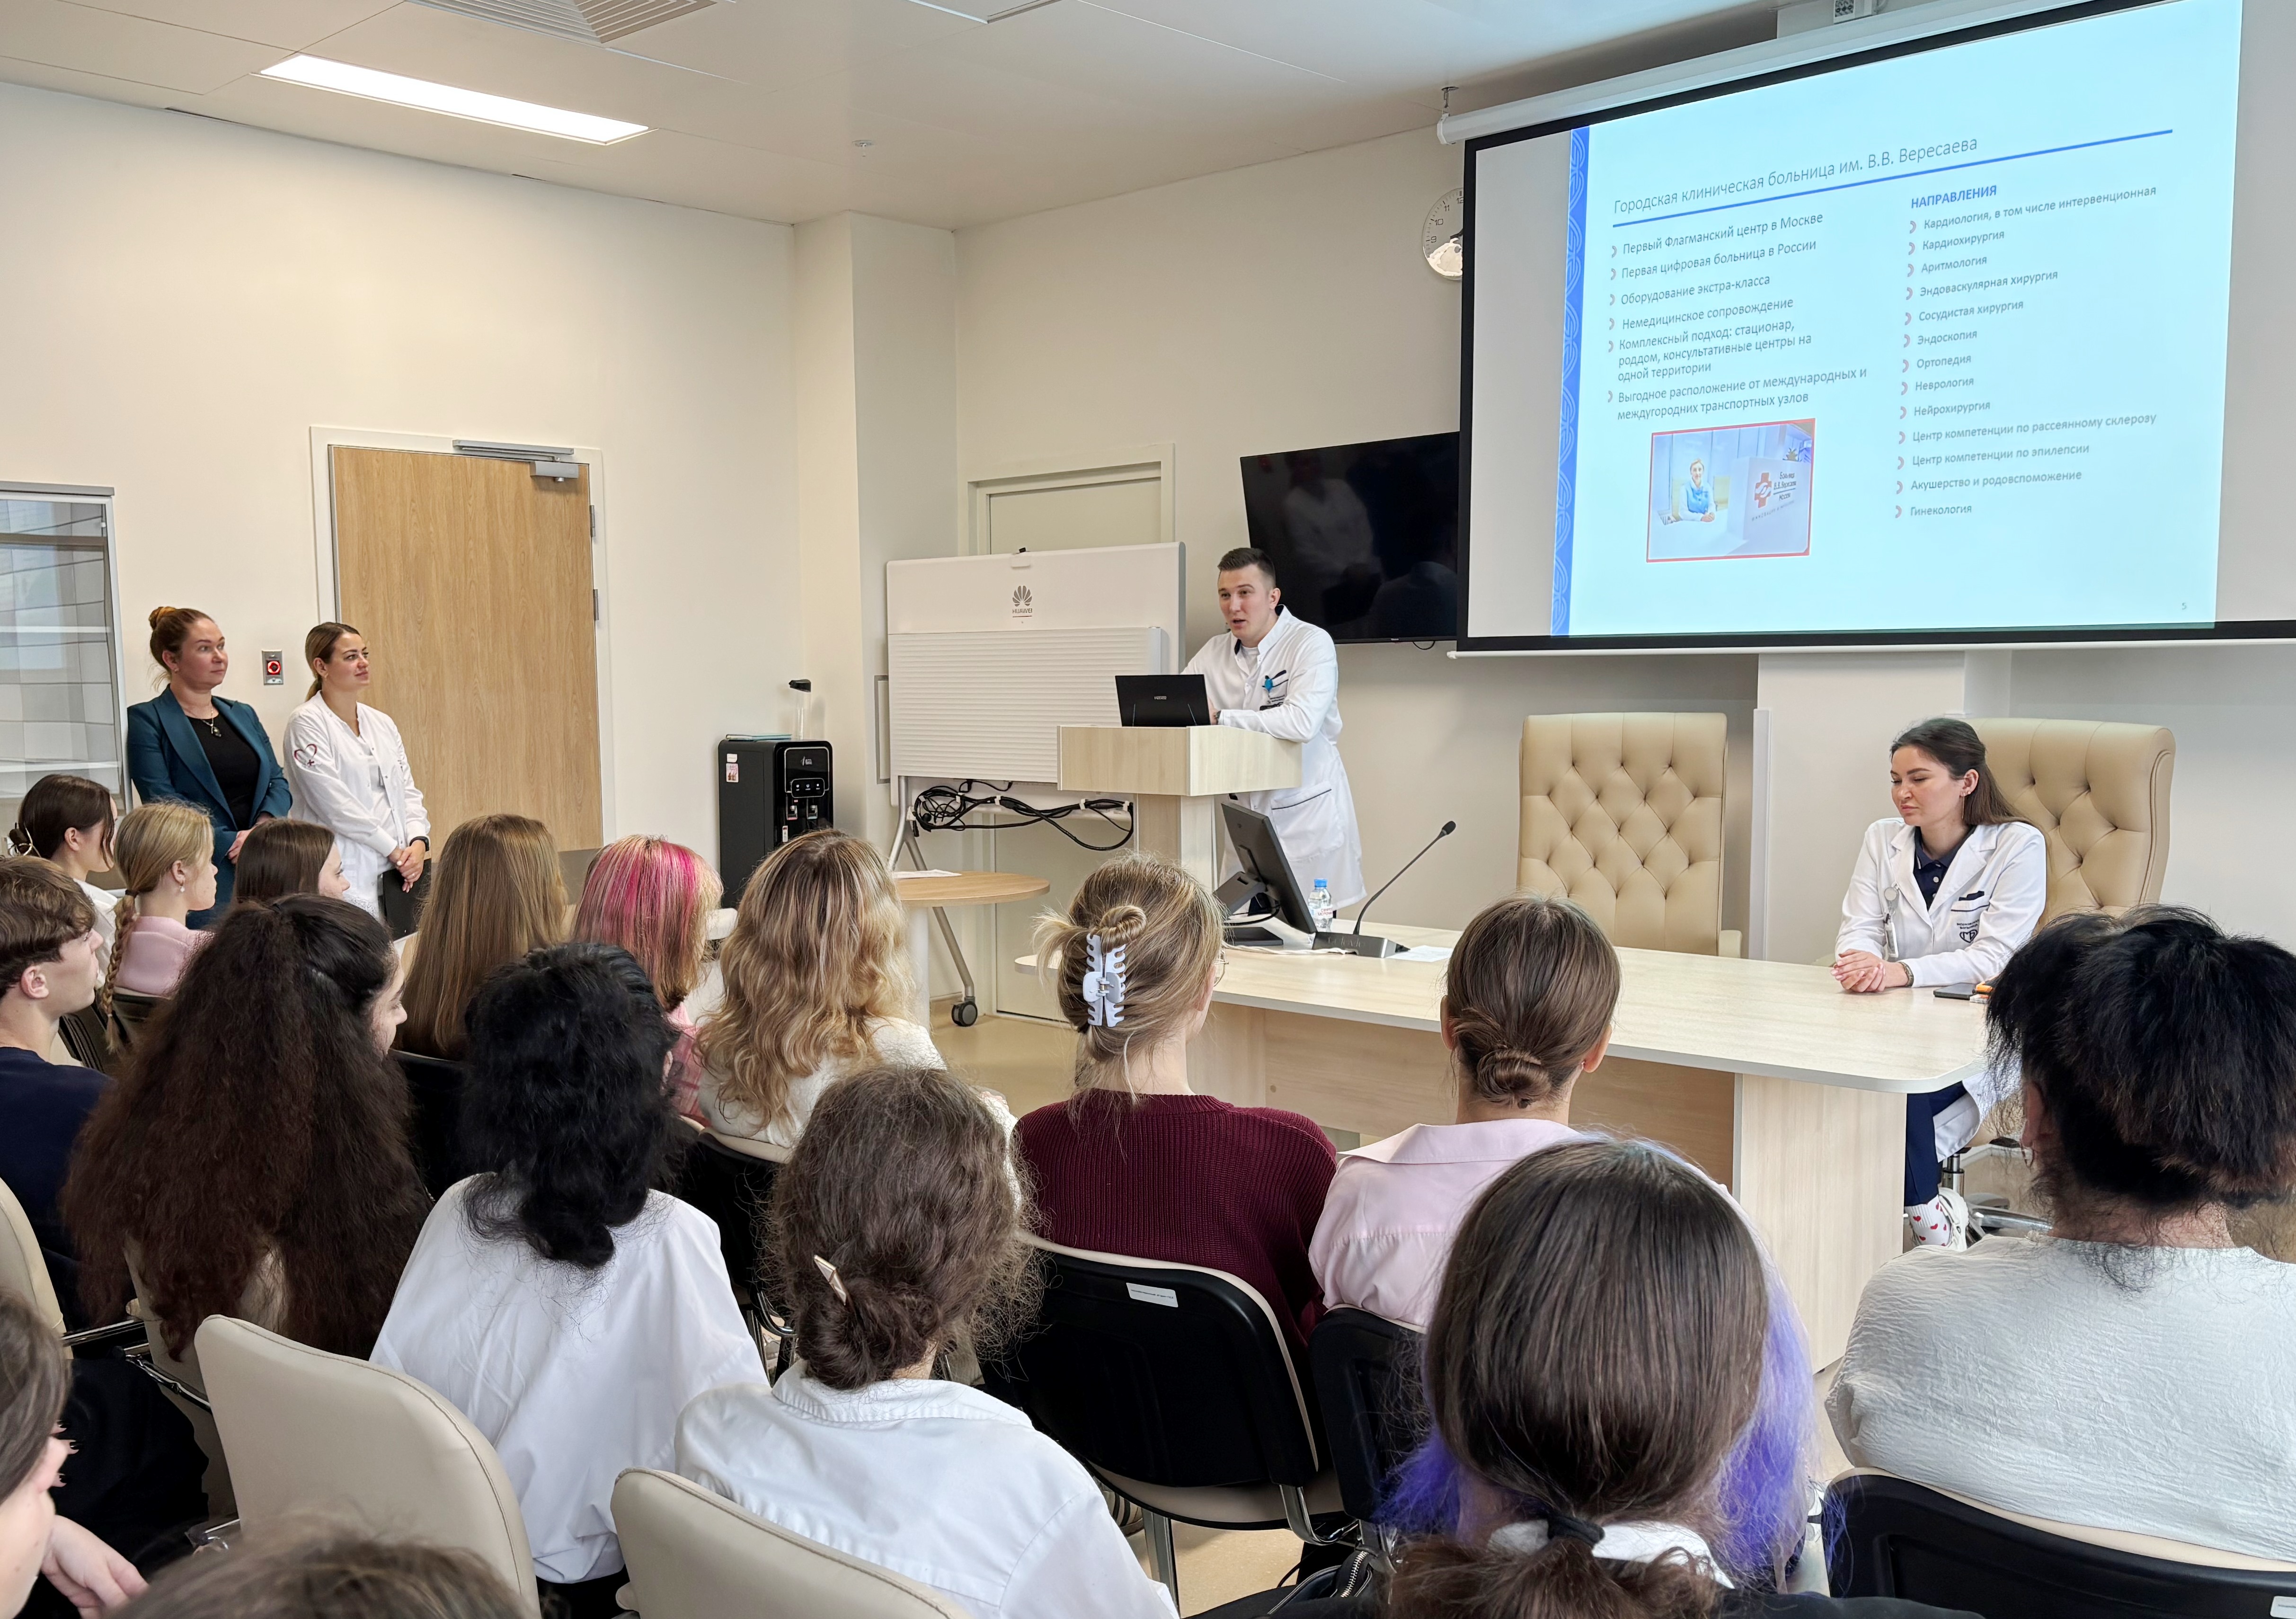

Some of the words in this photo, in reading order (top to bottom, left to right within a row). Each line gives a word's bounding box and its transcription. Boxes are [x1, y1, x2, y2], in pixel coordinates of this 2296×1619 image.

[1614, 193, 1677, 214] Городская
[1682, 177, 1764, 202] клиническая
[1768, 164, 1835, 187] больница
[1839, 160, 1863, 174] им.
[1868, 151, 1894, 169] В.В.
[1899, 138, 1977, 163] Вересаева
[1911, 184, 1997, 209] НАПРАВЛЕНИЯ
[1924, 212, 1992, 230] Кардиология,
[1995, 210, 2001, 219] в
[2003, 206, 2023, 217] том
[2025, 202, 2056, 213] числе
[2059, 187, 2156, 209] интервенционная
[1623, 237, 1662, 255] Первый
[1665, 225, 1734, 247] Флагманский
[1737, 223, 1768, 238] центр
[1771, 222, 1777, 231] в
[1780, 214, 1823, 229] Москве
[1923, 231, 2004, 251] Кардиохирургия
[1622, 265, 1658, 279] Первая
[1660, 257, 1711, 275] цифровая
[1714, 249, 1765, 265] больница
[1768, 247, 1774, 257] в
[1777, 240, 1816, 255] России
[1921, 257, 1987, 274] Аритмология
[1621, 286, 1695, 305] Оборудование
[1697, 276, 1770, 294] экстра-класса
[1920, 277, 2008, 297] Эндоваскулярная
[2010, 271, 2058, 286] хирургия
[1622, 311, 1704, 330] Немедицинское
[1707, 299, 1793, 319] сопровождение
[1919, 307, 1975, 321] Сосудистая
[1977, 301, 2024, 315] хирургия
[1619, 330, 1689, 350] Комплексный
[1691, 328, 1732, 343] подход:
[1735, 320, 1794, 336] стационар,
[1917, 330, 1977, 346] Эндоскопия
[1619, 353, 1660, 369] роддом,
[1663, 342, 1752, 361] консультативные
[1755, 337, 1795, 352] центры
[1799, 335, 1811, 345] на
[1916, 355, 1971, 370] Ортопедия
[1618, 366, 1649, 383] одной
[1651, 363, 1711, 379] территории
[1618, 390, 1667, 403] Выгодное
[1669, 382, 1746, 400] расположение
[1748, 380, 1761, 390] от
[1763, 369, 1857, 388] международных
[1860, 368, 1867, 378] и
[1915, 378, 1974, 391] Неврология
[1617, 404, 1698, 421] междугородних
[1700, 396, 1775, 414] транспортных
[1777, 393, 1808, 407] узлов
[1914, 402, 1991, 417] Нейрохирургия
[1913, 431, 1943, 443] Центр
[1945, 426, 2013, 439] компетенции
[2016, 424, 2030, 433] по
[2032, 418, 2103, 434] рассеянному
[2105, 414, 2157, 427] склерозу
[1913, 455, 1942, 467] Центр
[1944, 451, 2013, 463] компетенции
[2016, 449, 2030, 458] по
[2031, 445, 2089, 457] эпилепсии
[1910, 479, 1971, 492] Акушерство
[1973, 478, 1980, 486] и
[1982, 471, 2082, 488] родовспоможение
[1910, 505, 1972, 516] Гинекология
[2181, 602, 2187, 610] 5
